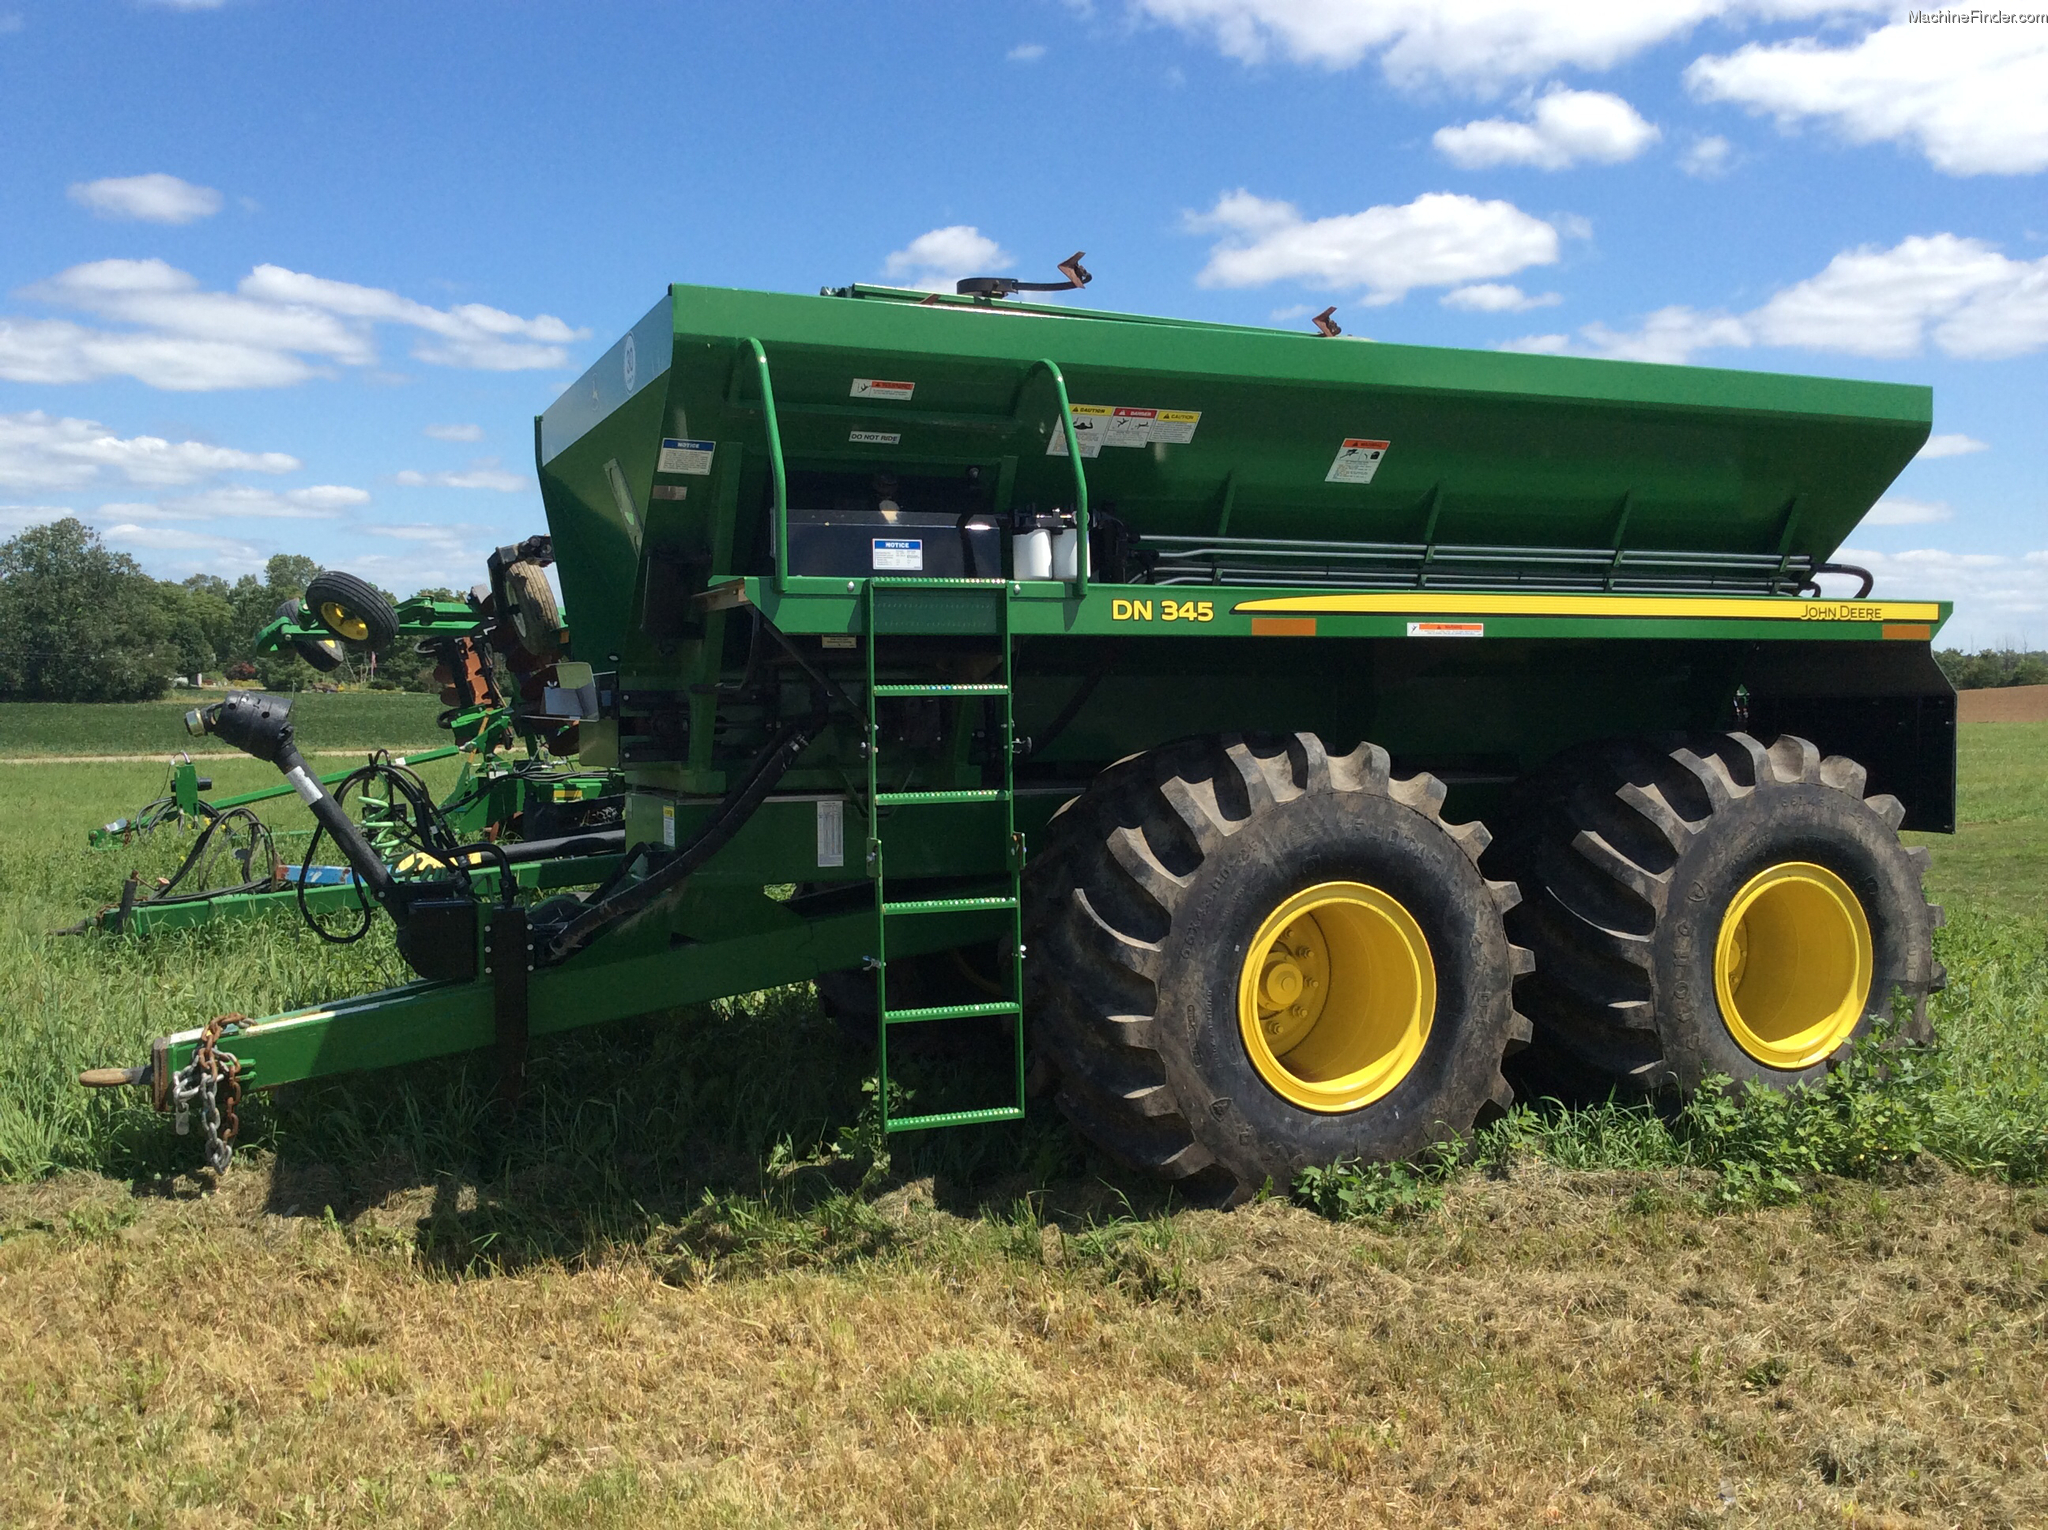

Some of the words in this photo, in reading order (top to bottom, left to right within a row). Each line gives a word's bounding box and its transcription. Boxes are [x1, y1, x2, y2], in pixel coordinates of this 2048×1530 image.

[1079, 406, 1106, 414] CAUTION
[1130, 410, 1152, 418] DANGER
[1112, 599, 1153, 621] DN
[1161, 600, 1215, 622] 345
